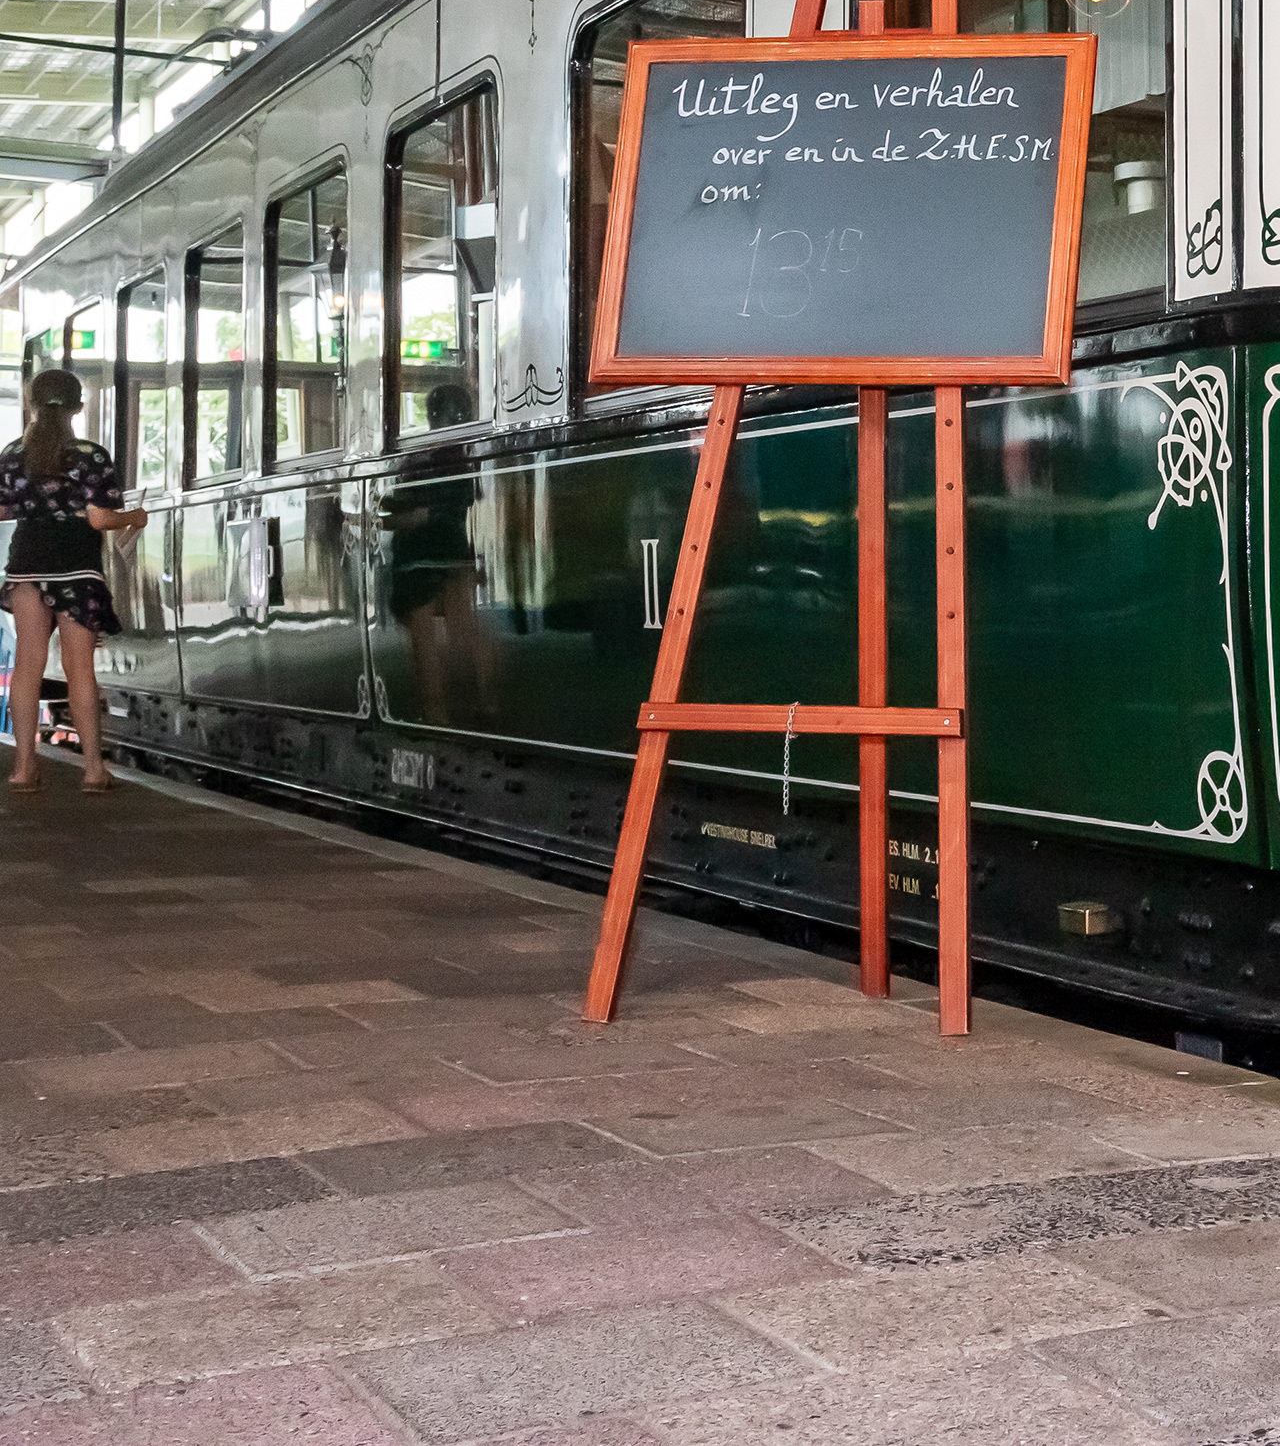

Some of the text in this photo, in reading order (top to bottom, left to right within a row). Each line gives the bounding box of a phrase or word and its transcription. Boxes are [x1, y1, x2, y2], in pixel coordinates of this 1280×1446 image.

[672, 67, 1020, 142] Uitleg en verhalen
[712, 147, 772, 166] over
[784, 146, 824, 163] en
[831, 137, 864, 163] in
[871, 129, 910, 162] de
[700, 182, 762, 204] om:
[640, 538, 663, 629] II
